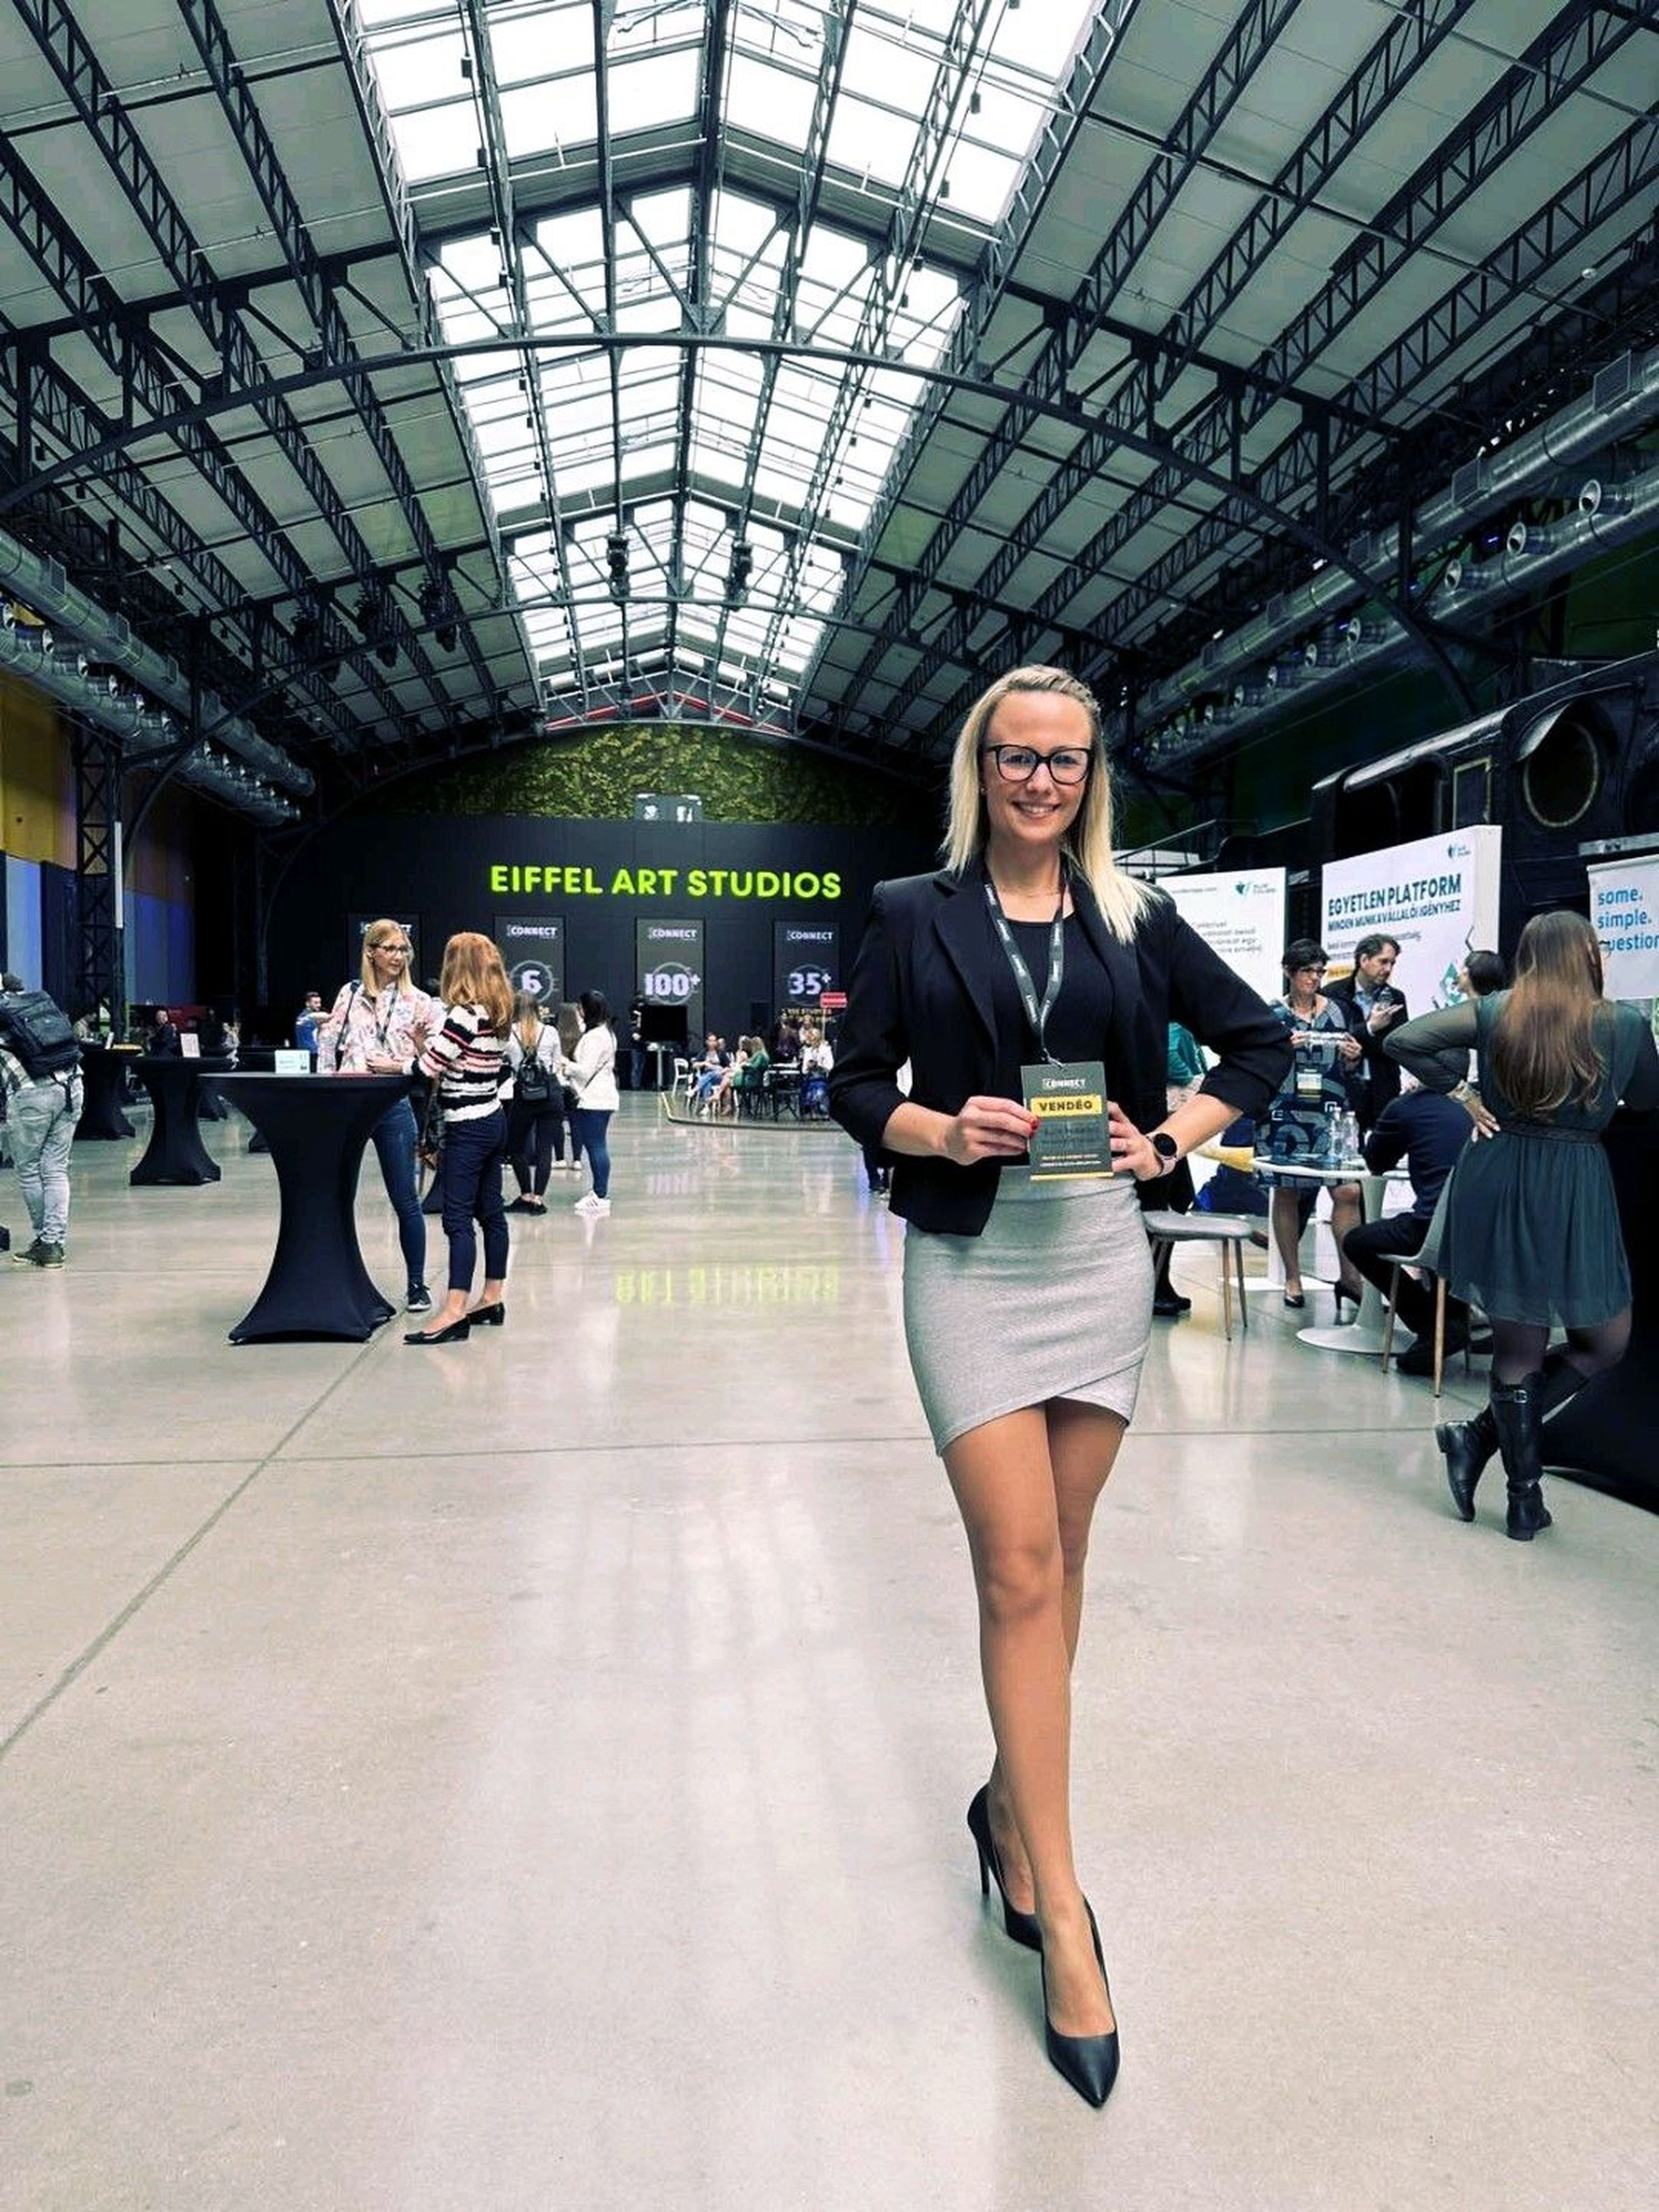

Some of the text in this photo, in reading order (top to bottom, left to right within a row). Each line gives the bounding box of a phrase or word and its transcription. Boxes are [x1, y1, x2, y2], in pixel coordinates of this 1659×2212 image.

[491, 865, 841, 898] EIFFEL ART STUDIOS
[1328, 873, 1461, 916] EGYETLEN PLATFORM
[1599, 889, 1643, 906] some.
[1598, 909, 1652, 929] simple.
[1600, 932, 1659, 951] uestion
[521, 969, 543, 994] 6
[1039, 1100, 1093, 1112] VENDÉG
